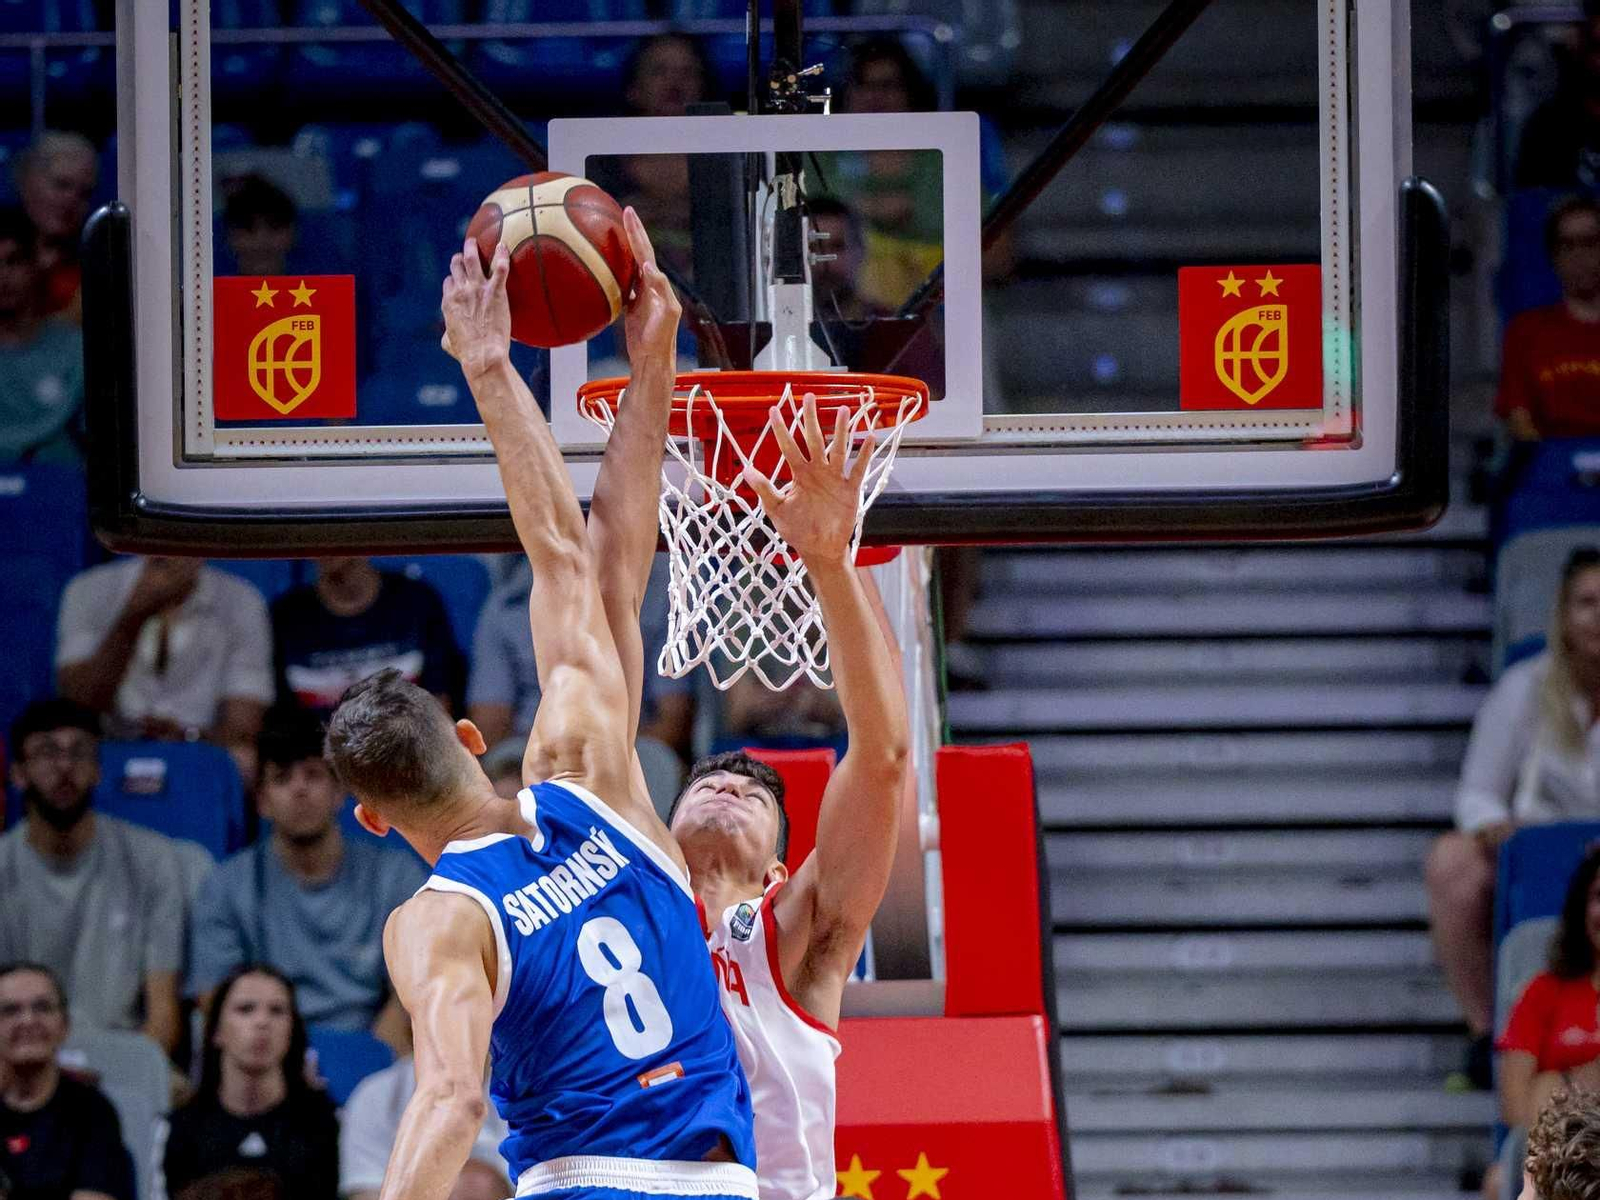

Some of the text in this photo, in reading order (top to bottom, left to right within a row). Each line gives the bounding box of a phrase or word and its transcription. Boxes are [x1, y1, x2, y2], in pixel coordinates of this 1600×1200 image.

[1258, 310, 1281, 321] FEB
[291, 320, 315, 331] FEB
[577, 916, 673, 1060] 8
